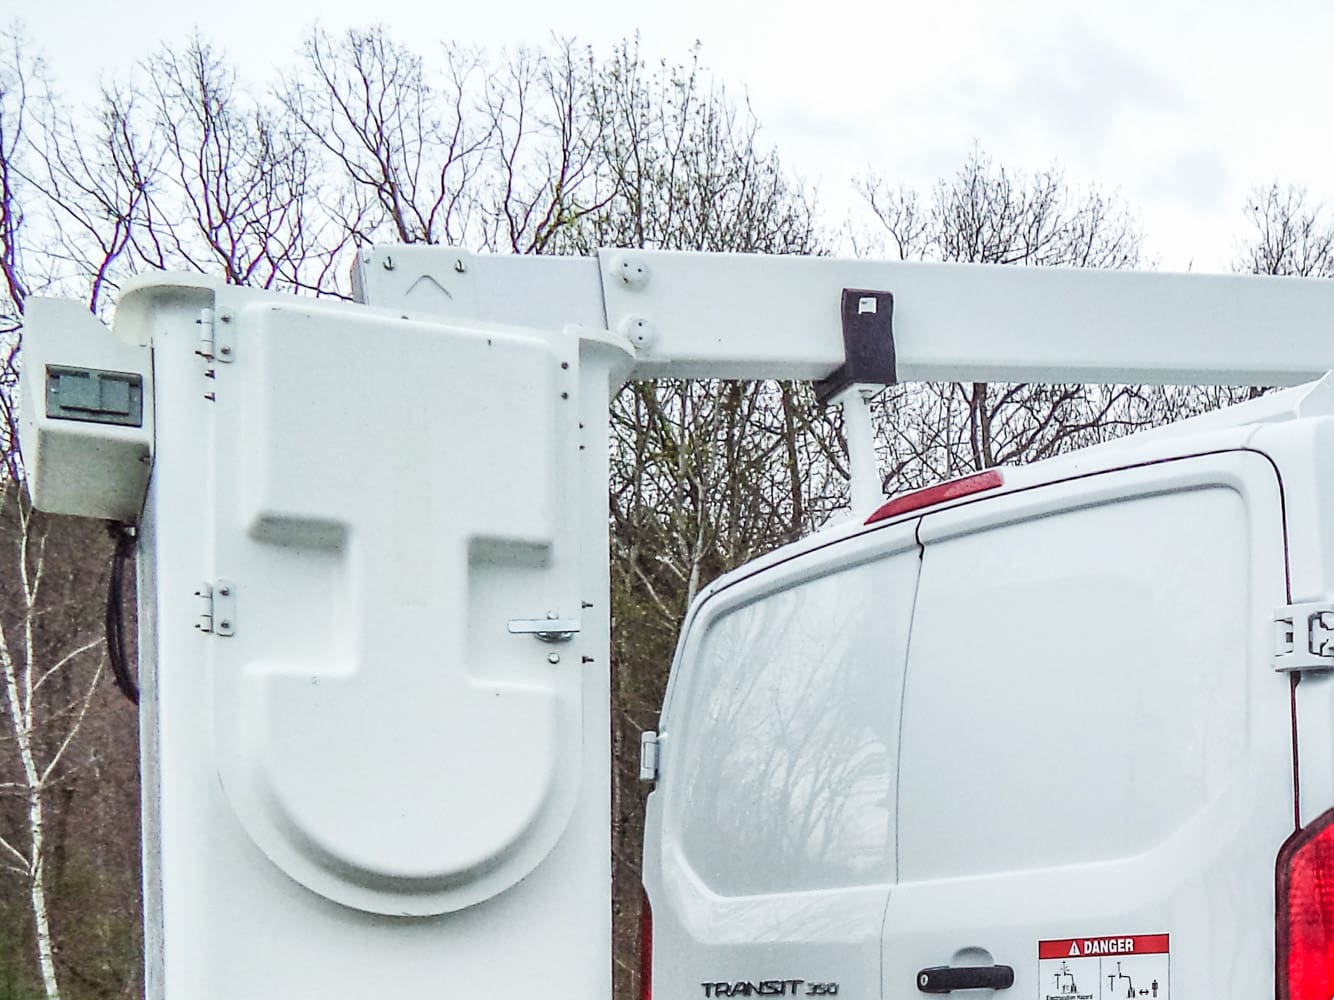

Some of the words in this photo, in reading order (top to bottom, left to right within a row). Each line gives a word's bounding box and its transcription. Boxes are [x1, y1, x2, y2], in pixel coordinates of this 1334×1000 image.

[1084, 938, 1134, 954] DANGER
[701, 979, 804, 998] TRANSIT
[806, 982, 839, 996] 350
